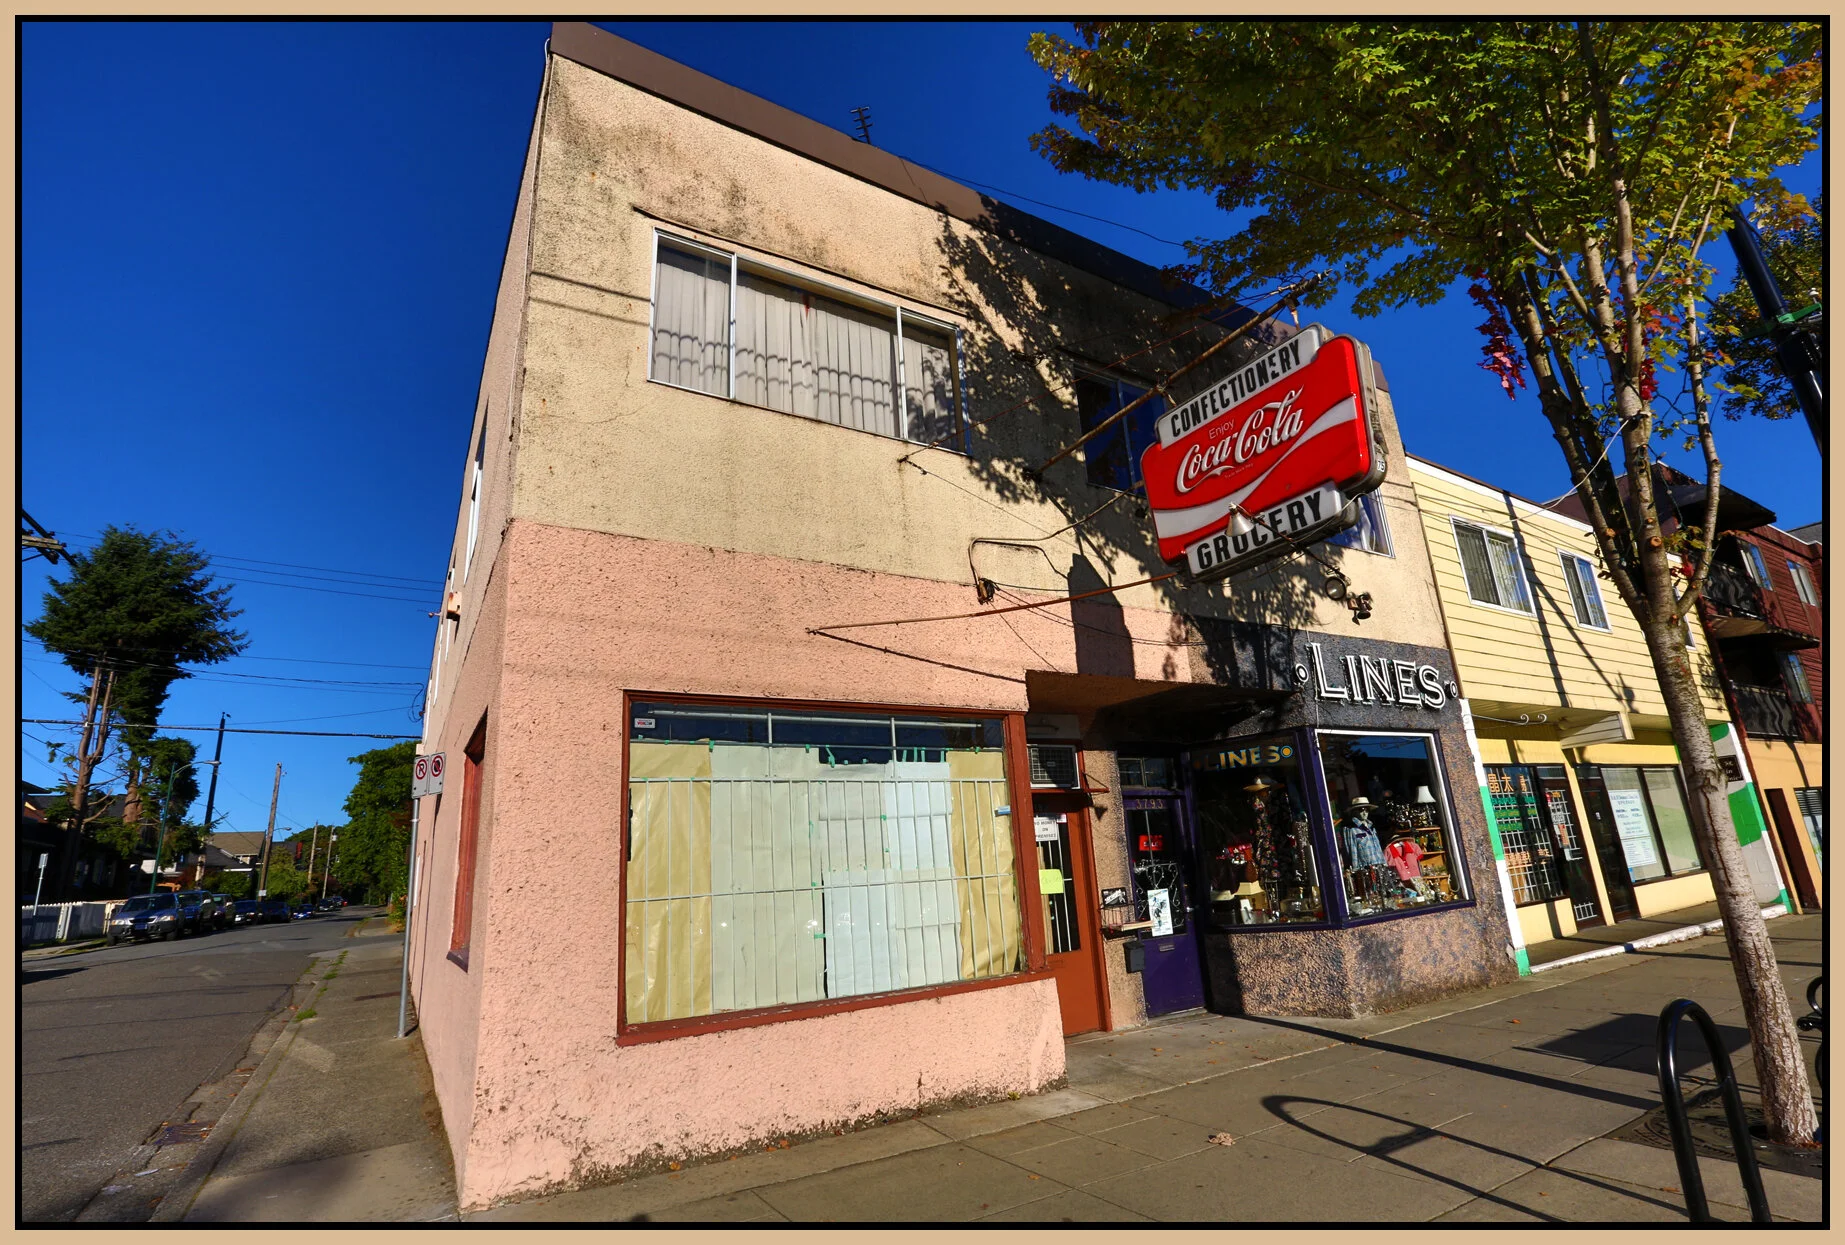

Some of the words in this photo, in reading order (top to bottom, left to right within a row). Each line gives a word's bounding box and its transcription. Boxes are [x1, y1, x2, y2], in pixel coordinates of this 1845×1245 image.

[1171, 338, 1302, 438] CONFECTIONERY
[1176, 384, 1305, 494] Coca-Cola
[1208, 417, 1236, 440] Enjoy
[1197, 490, 1323, 570] GROCERY
[1310, 642, 1446, 709] LINES
[1203, 745, 1281, 771] LINES
[1136, 798, 1164, 809] 3793
